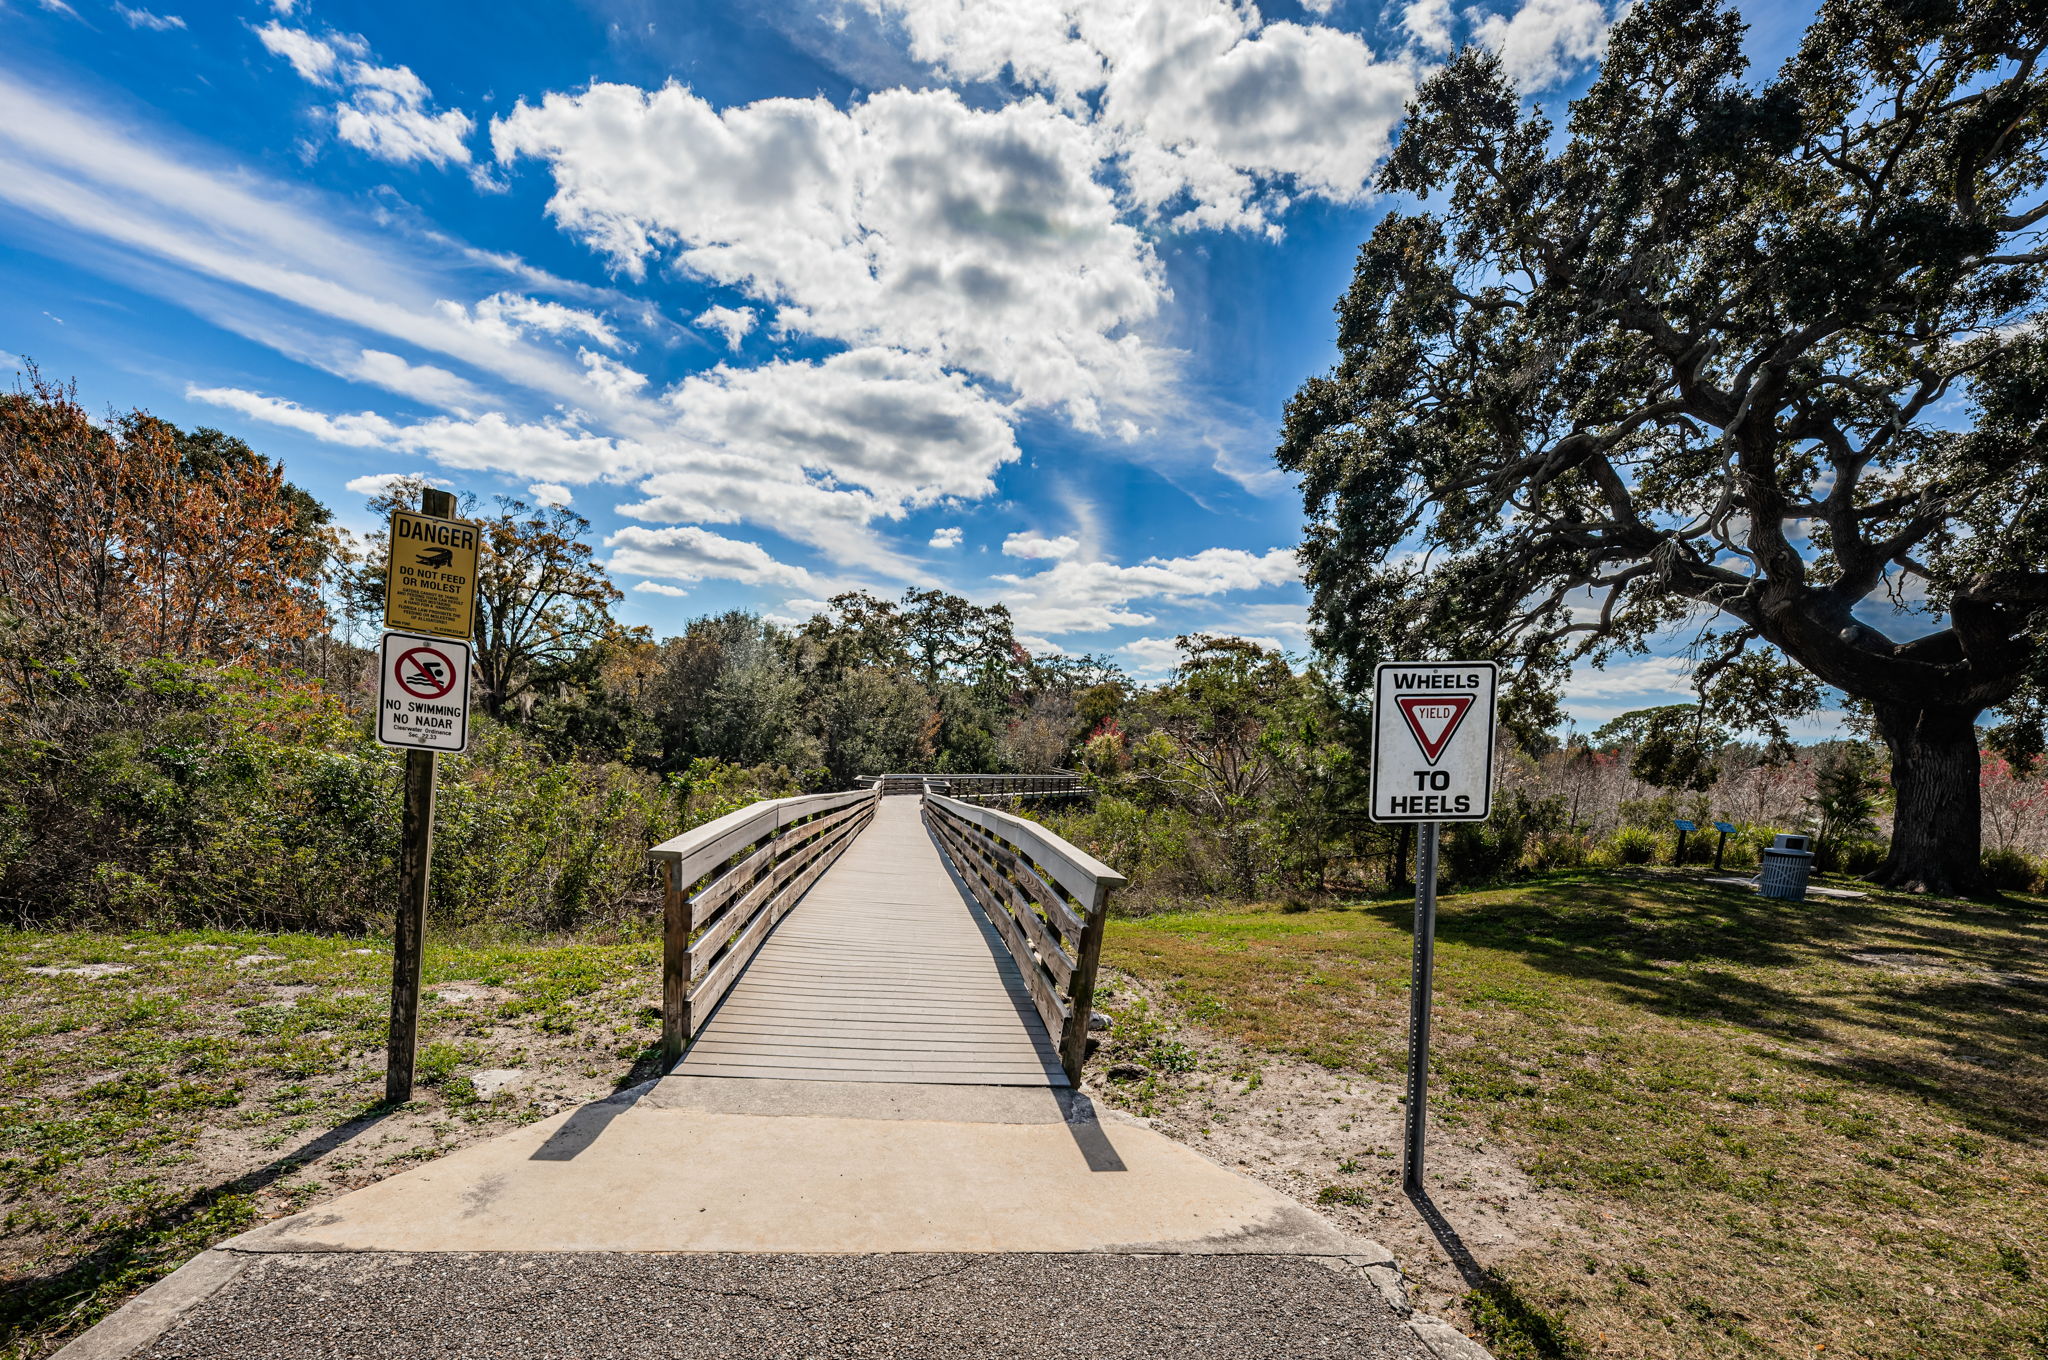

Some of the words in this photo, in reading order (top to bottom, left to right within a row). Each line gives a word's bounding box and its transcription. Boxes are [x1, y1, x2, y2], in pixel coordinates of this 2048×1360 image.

[399, 519, 473, 550] DANGER
[400, 566, 414, 575] DO
[418, 569, 438, 579] NOT
[441, 573, 465, 584] FEED
[403, 577, 417, 586] OR
[421, 580, 461, 594] MOLEST
[1394, 674, 1480, 689] WHEELS
[386, 699, 401, 710] NO
[408, 702, 460, 717] SWIMMING
[1420, 708, 1450, 718] YIELD
[394, 713, 408, 724] NO
[416, 716, 452, 729] NADAR
[394, 725, 422, 733] Clearwater
[425, 728, 451, 736] Ordinance
[1414, 771, 1450, 791] TO
[1391, 795, 1470, 813] HEELS
